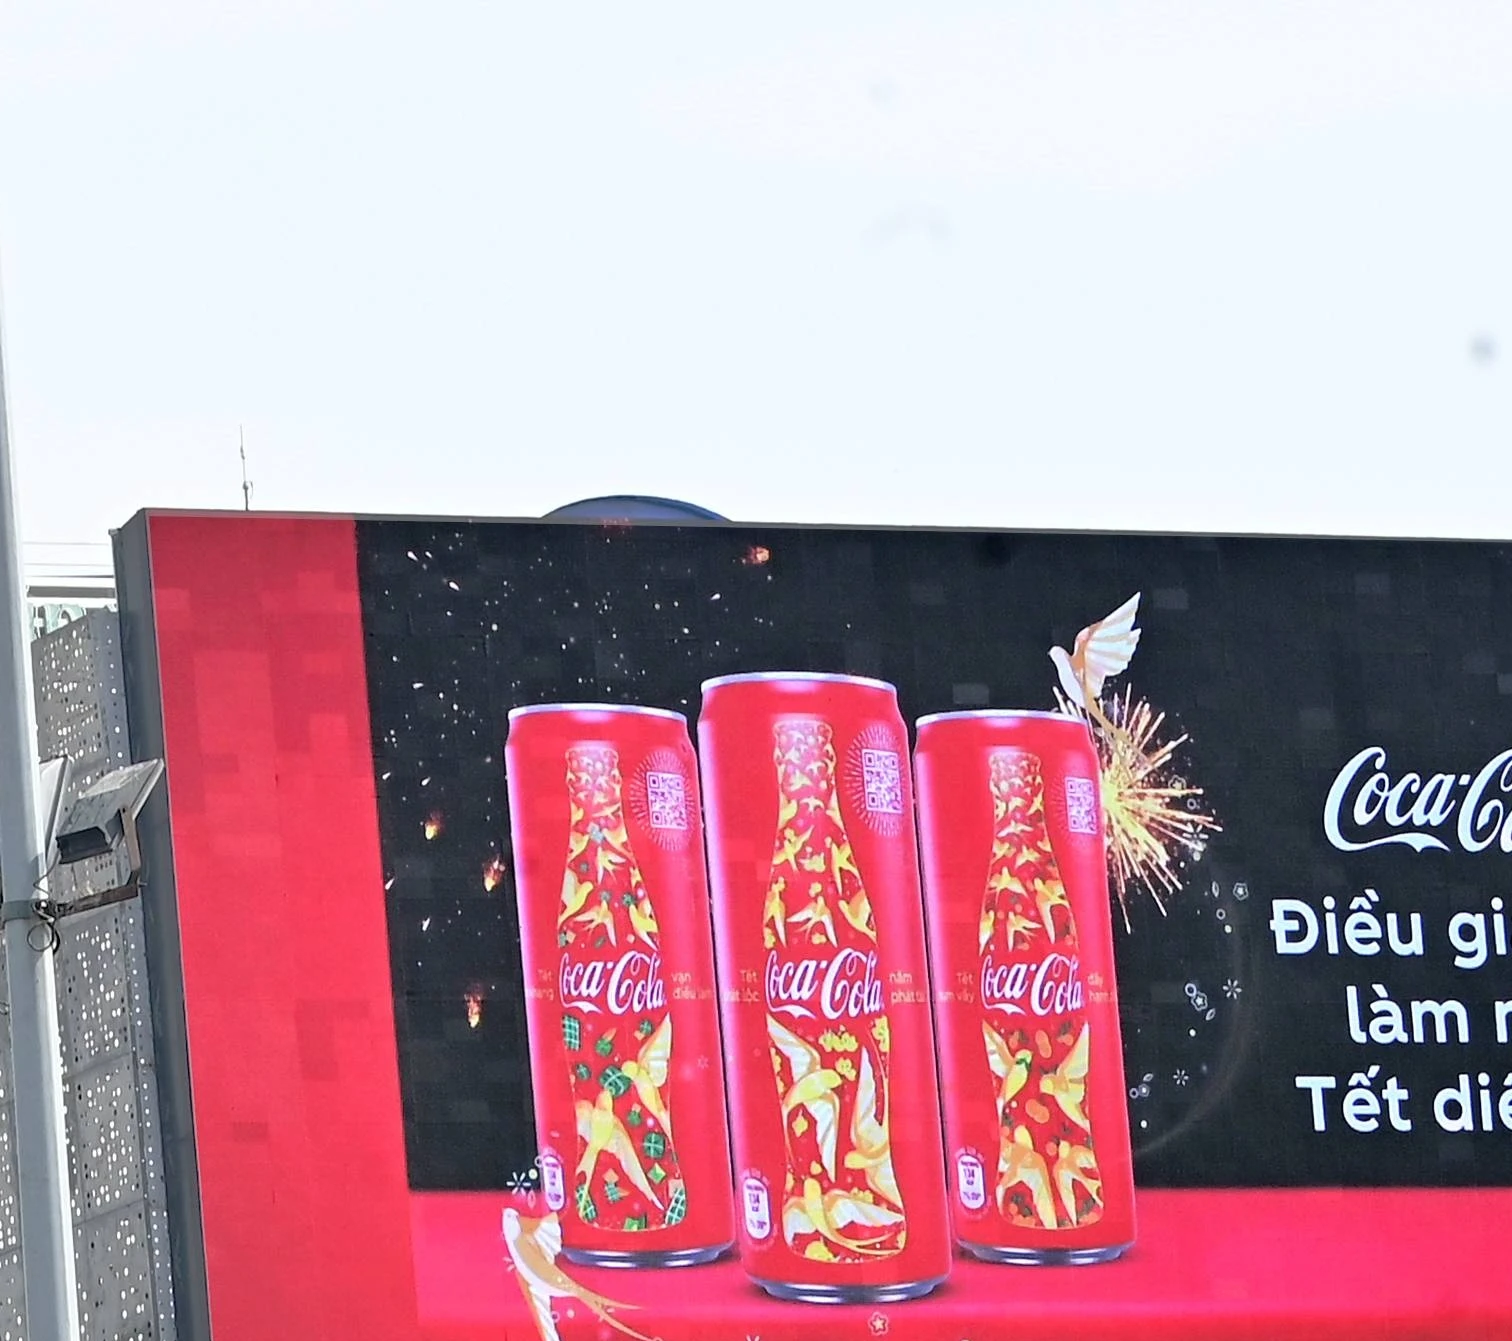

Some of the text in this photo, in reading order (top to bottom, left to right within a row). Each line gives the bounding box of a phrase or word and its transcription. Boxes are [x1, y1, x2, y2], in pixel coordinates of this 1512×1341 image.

[1270, 889, 1424, 956] Điều
[1345, 984, 1470, 1043] làm
[1295, 1065, 1412, 1132] Tết
